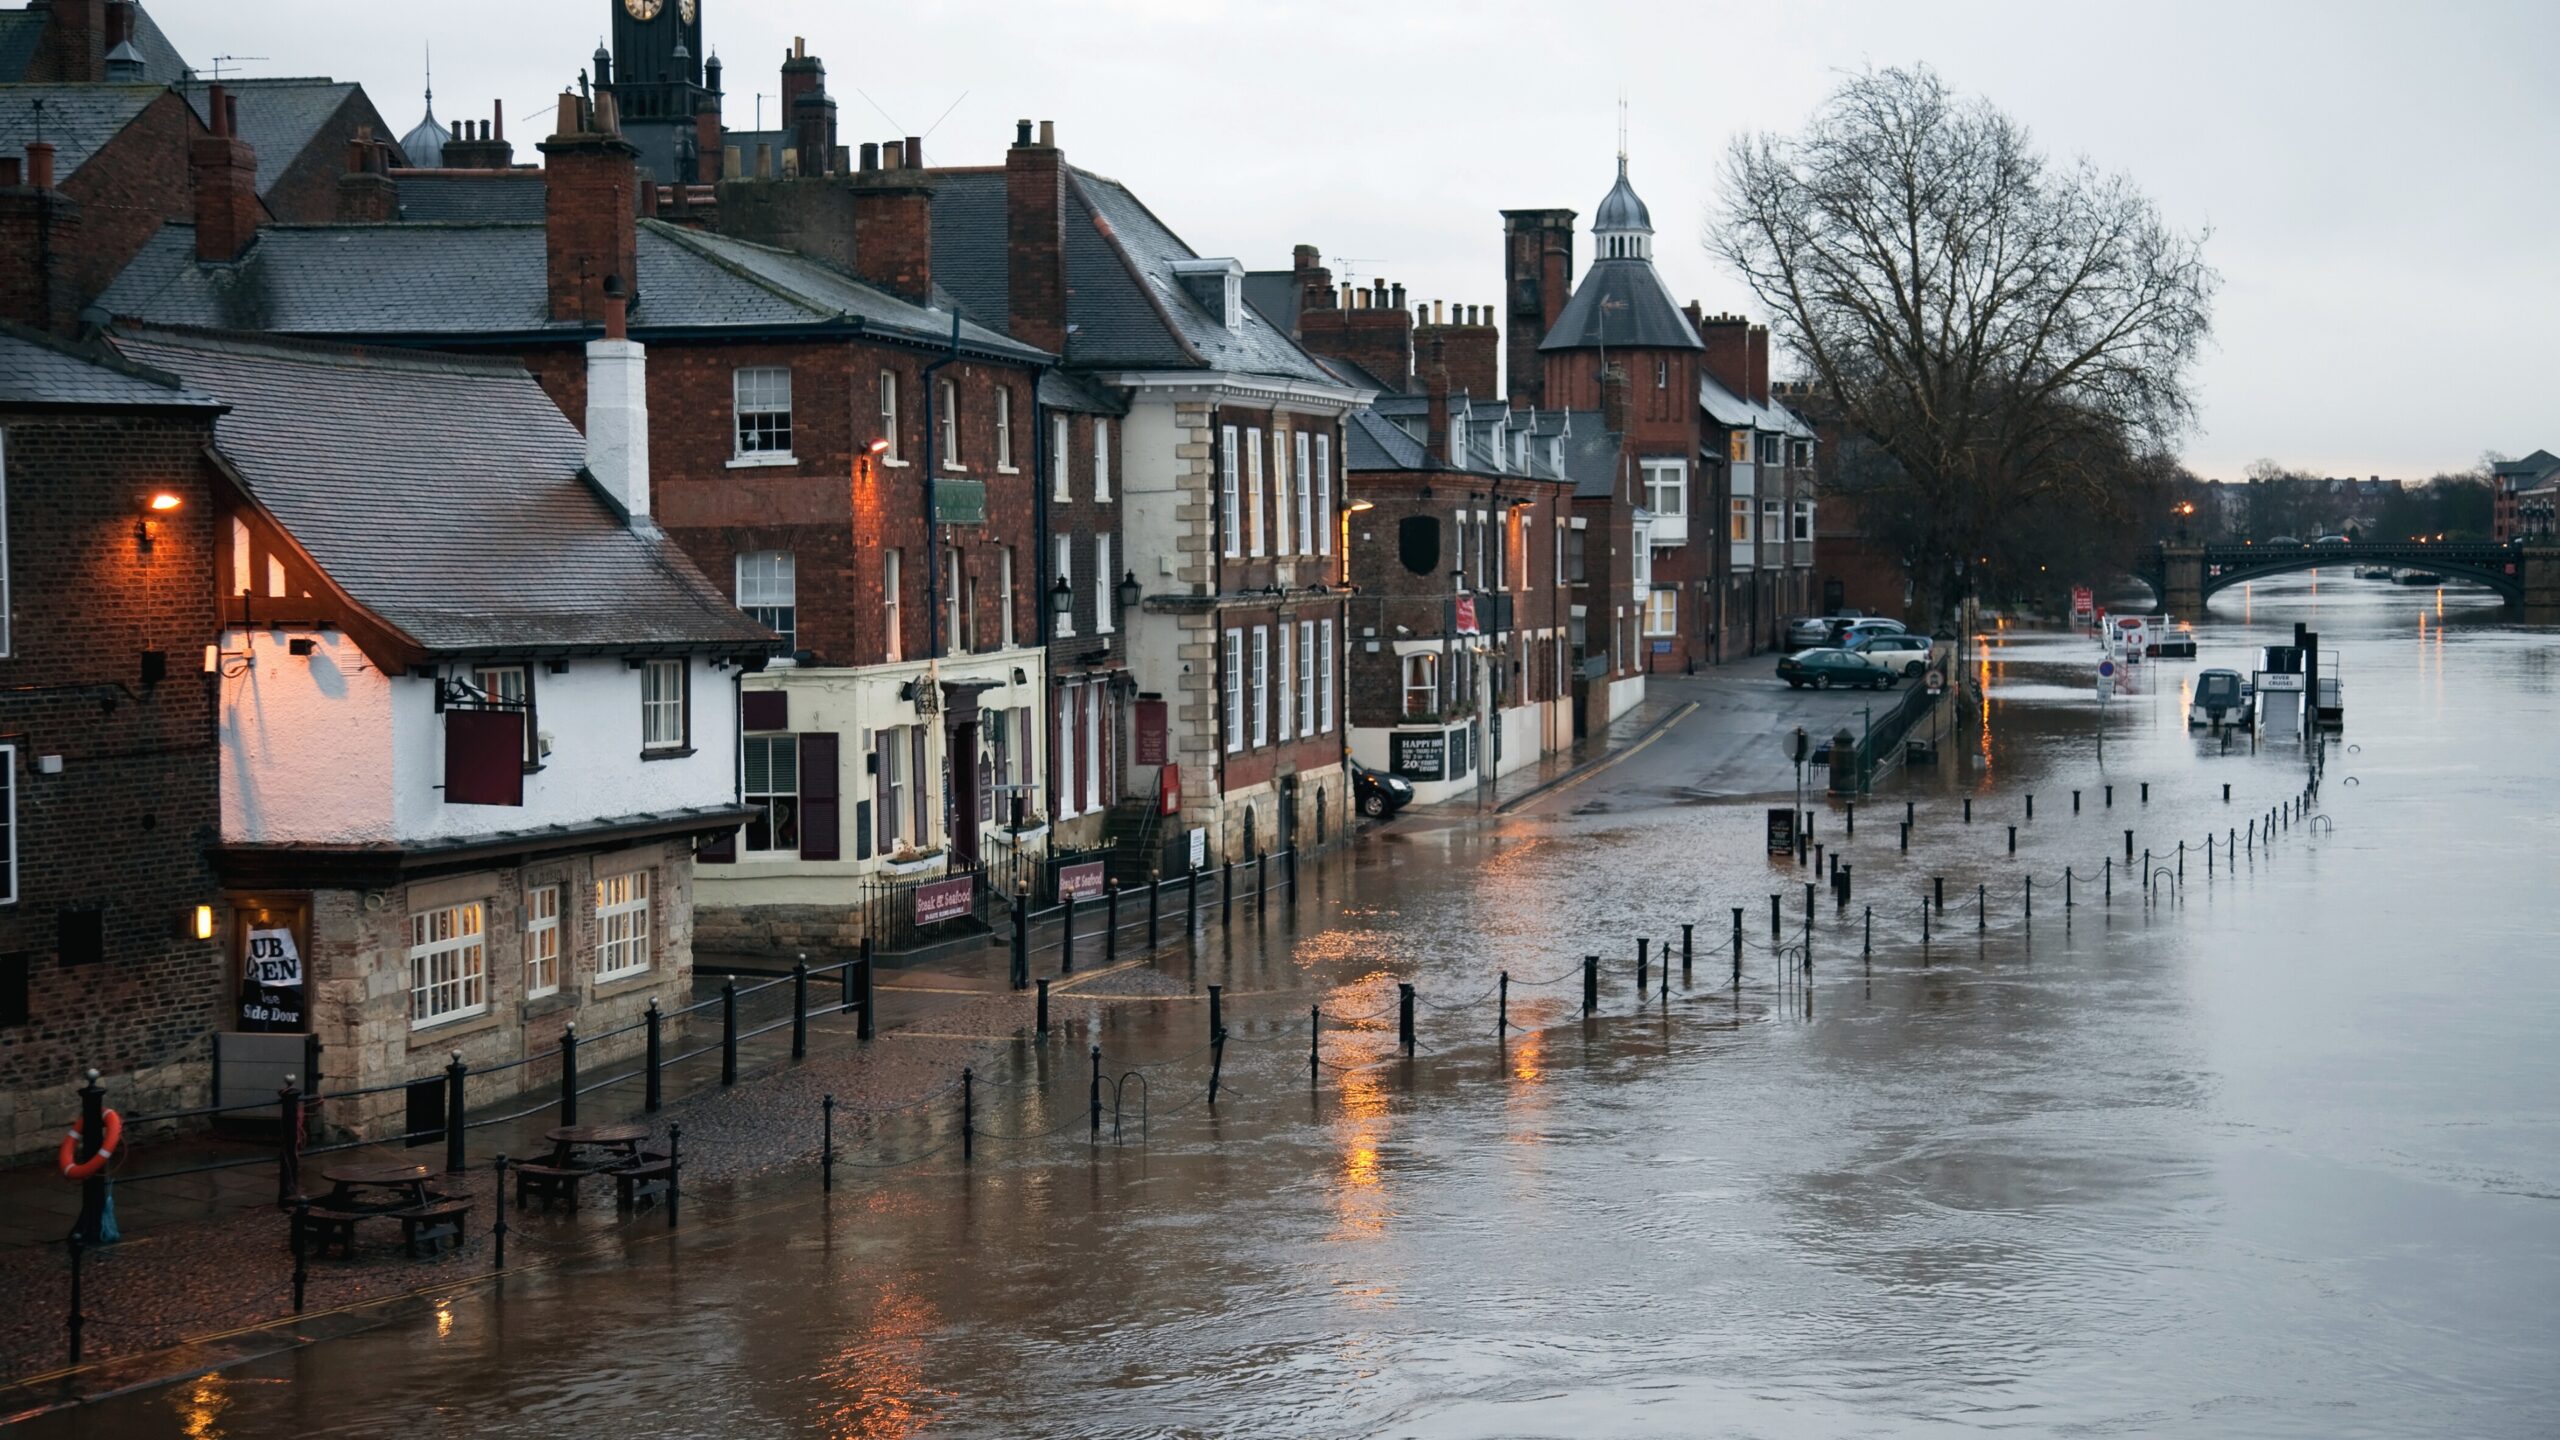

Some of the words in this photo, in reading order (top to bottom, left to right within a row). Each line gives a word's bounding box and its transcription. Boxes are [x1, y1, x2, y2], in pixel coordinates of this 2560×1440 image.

[1402, 740, 1430, 748] HAPPY
[1081, 871, 1102, 887] Seafood
[917, 895, 936, 913] Steak
[936, 894, 944, 909] &
[945, 887, 971, 907] Seafood
[250, 938, 284, 958] UB
[243, 1004, 268, 1020] Sde
[271, 1007, 299, 1022] Door
